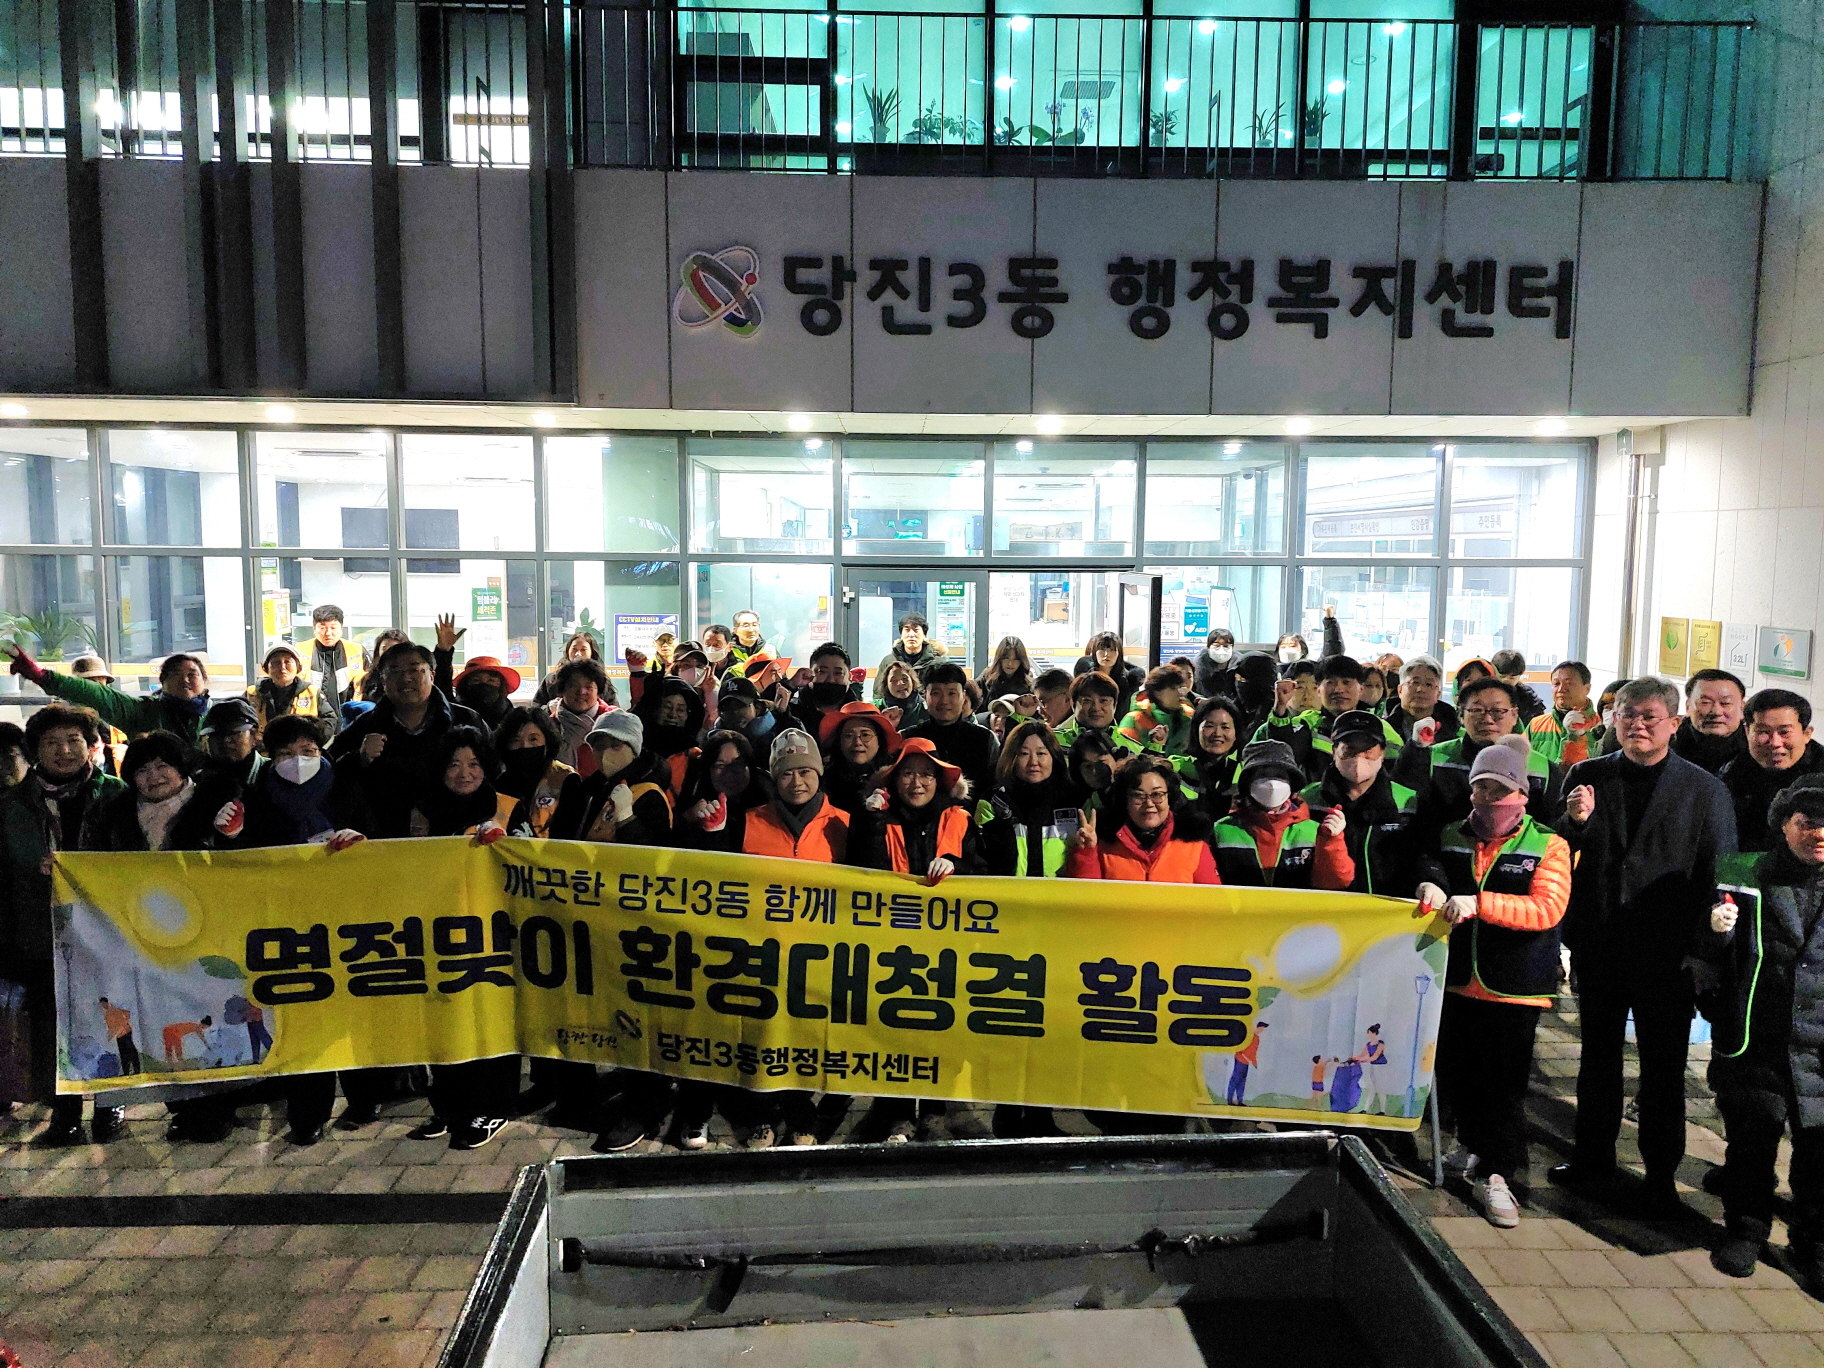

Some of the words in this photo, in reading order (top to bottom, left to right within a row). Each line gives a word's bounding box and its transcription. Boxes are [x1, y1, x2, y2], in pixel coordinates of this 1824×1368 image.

[782, 256, 1069, 338] 당진3동
[1107, 257, 1574, 341] 행정복지센터
[1478, 514, 1502, 529] 주민등록
[727, 681, 738, 691] LA
[503, 863, 605, 908] 깨끗한
[618, 872, 750, 918] 당진3동
[764, 883, 837, 925] 함께
[851, 891, 999, 934] 만들어요
[245, 910, 593, 1005] 명절맞이
[618, 925, 1047, 1038] 환경대청결
[1078, 956, 1253, 1050] 활동
[657, 1031, 940, 1084] 당진3동행정복지센터
